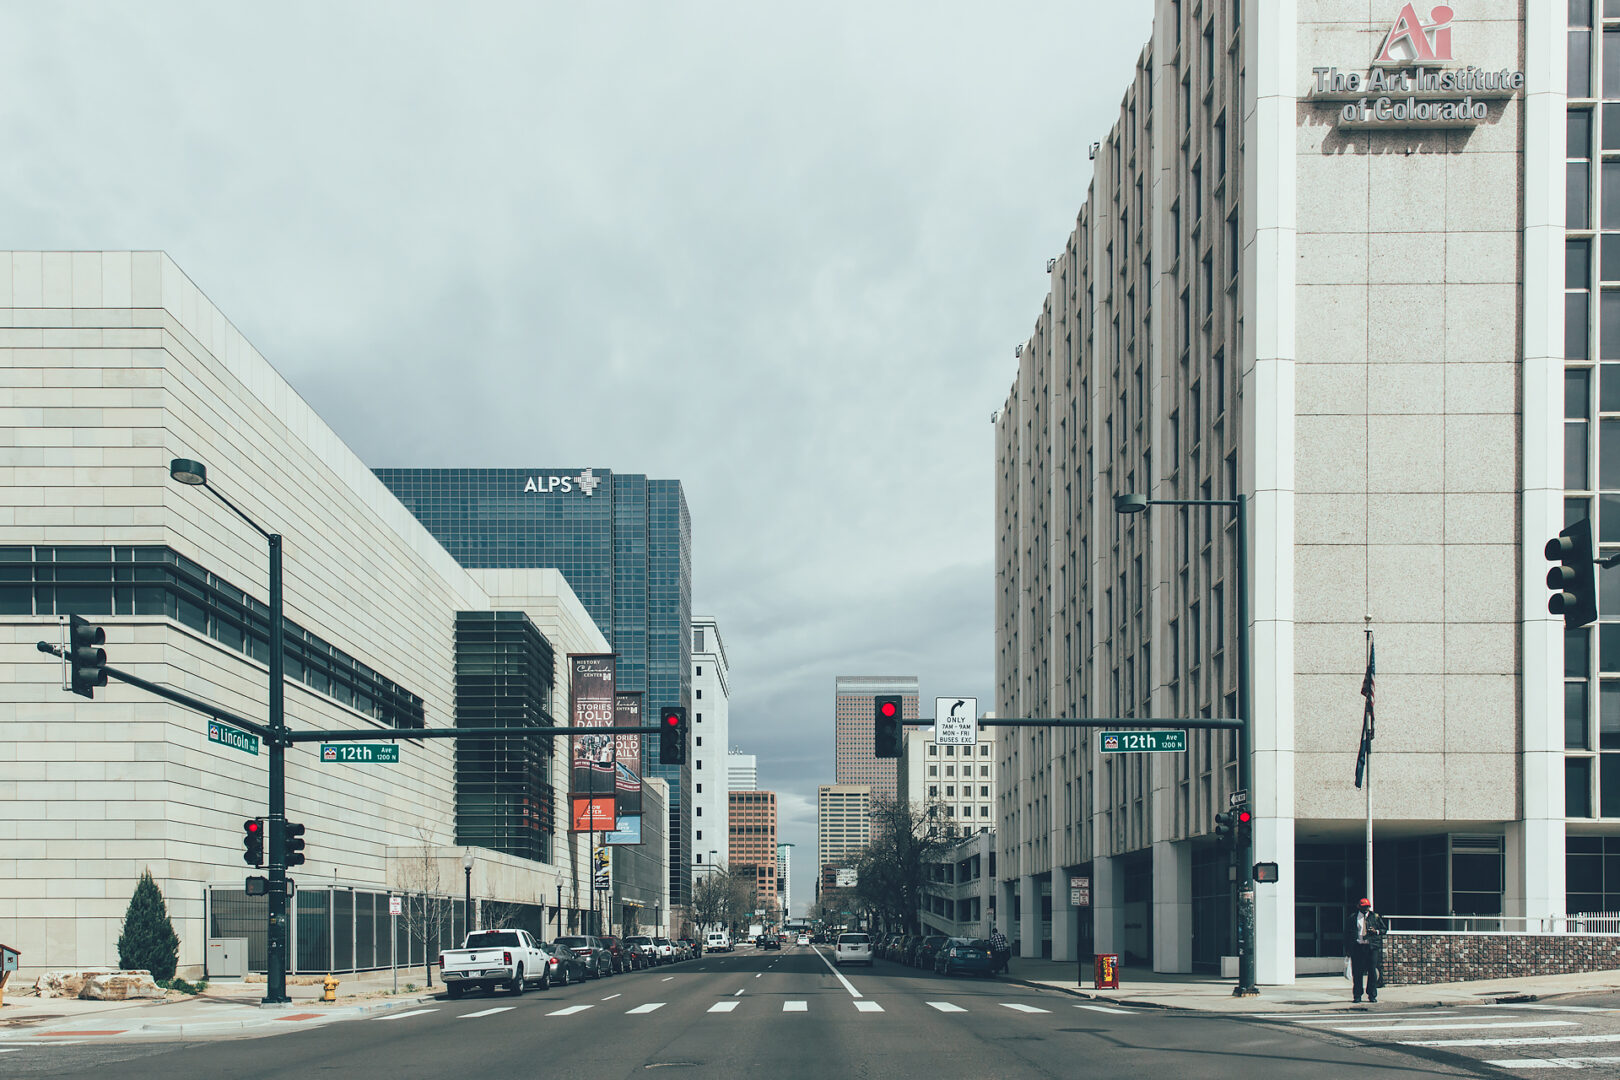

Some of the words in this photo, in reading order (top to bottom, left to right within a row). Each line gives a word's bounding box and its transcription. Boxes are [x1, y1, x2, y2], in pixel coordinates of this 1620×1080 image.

[1312, 67, 1361, 91] The
[1368, 67, 1409, 91] Art
[1417, 65, 1524, 91] Institute
[1343, 97, 1368, 121] of
[1375, 96, 1488, 121] Colorado
[523, 476, 572, 493] ALPS
[576, 711, 612, 721] TOLD
[220, 727, 249, 750] Lincoln
[615, 741, 638, 749] OLD
[1122, 734, 1156, 749] 12th
[340, 746, 372, 760] 12th
[615, 749, 640, 757] AILY
